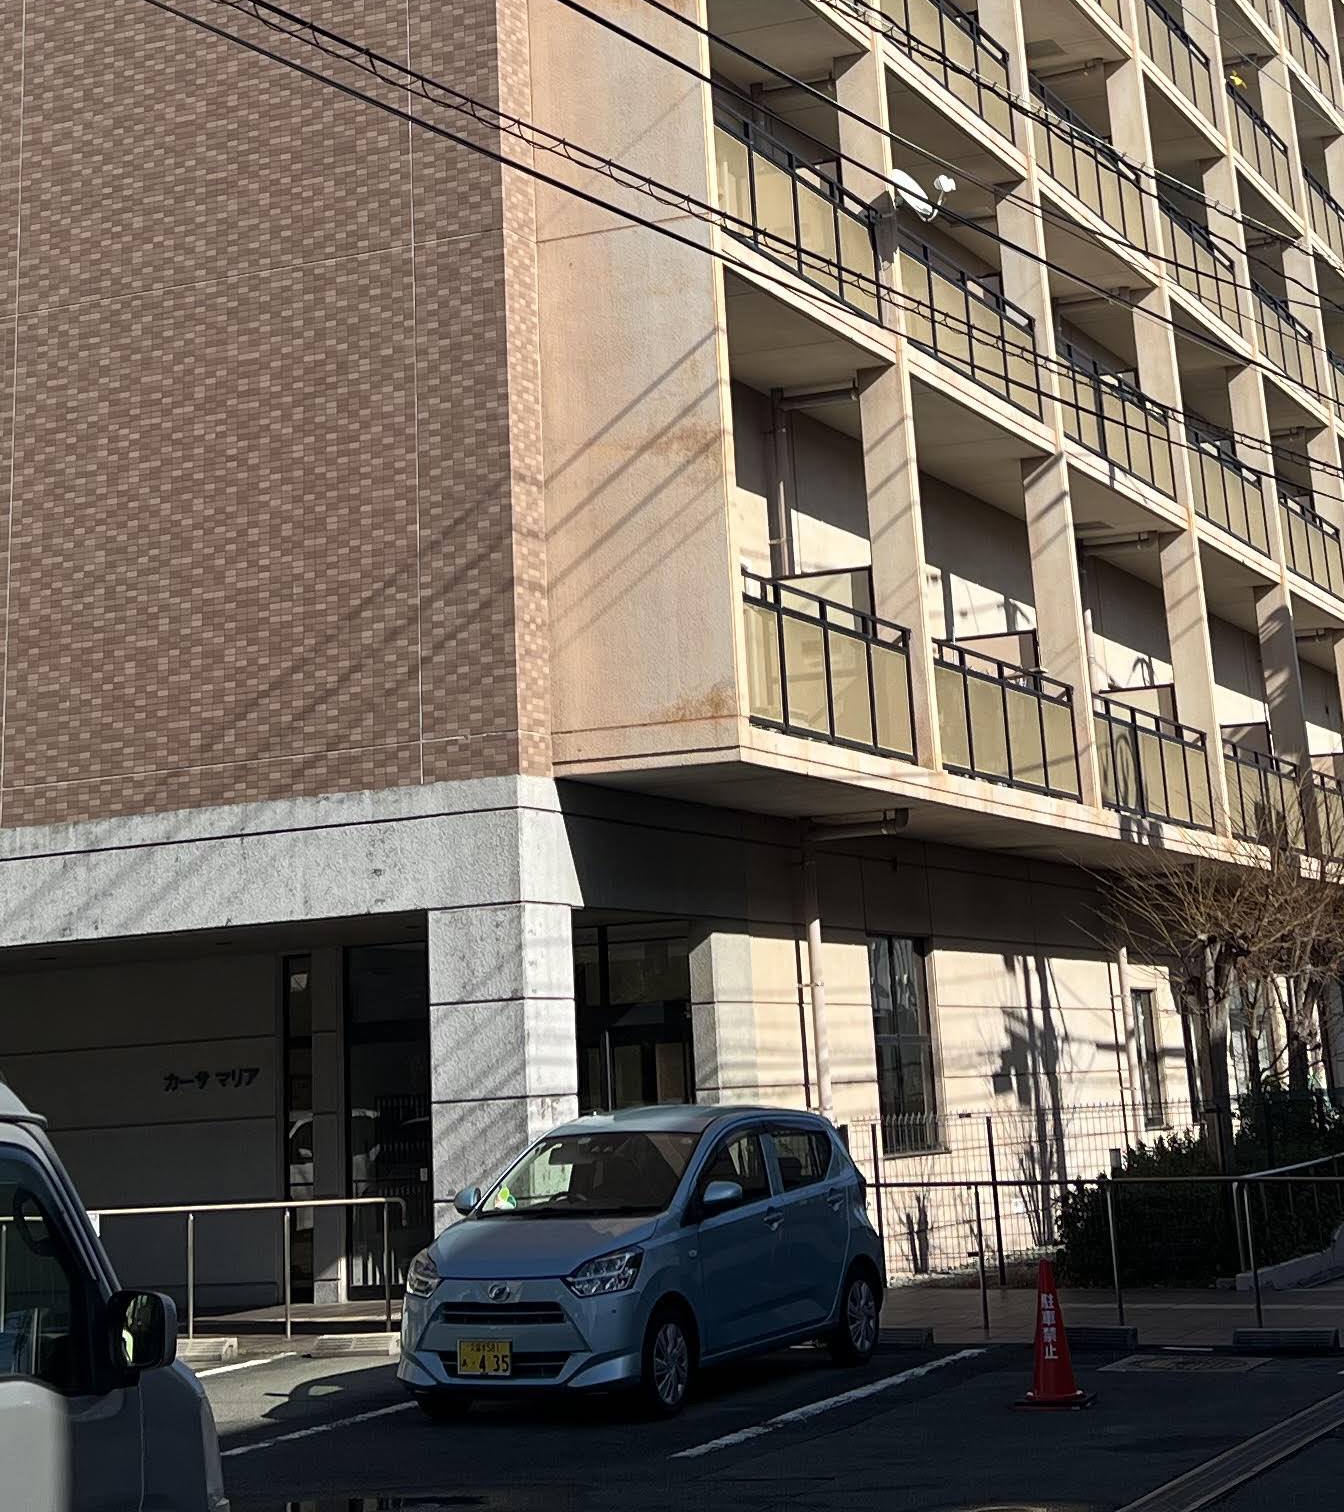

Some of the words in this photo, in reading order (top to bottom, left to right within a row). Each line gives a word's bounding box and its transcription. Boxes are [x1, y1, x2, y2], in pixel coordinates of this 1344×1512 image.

[163, 1071, 210, 1092] カーサ
[215, 1068, 260, 1088] マリア
[1041, 1293, 1058, 1360] 駐車禁止
